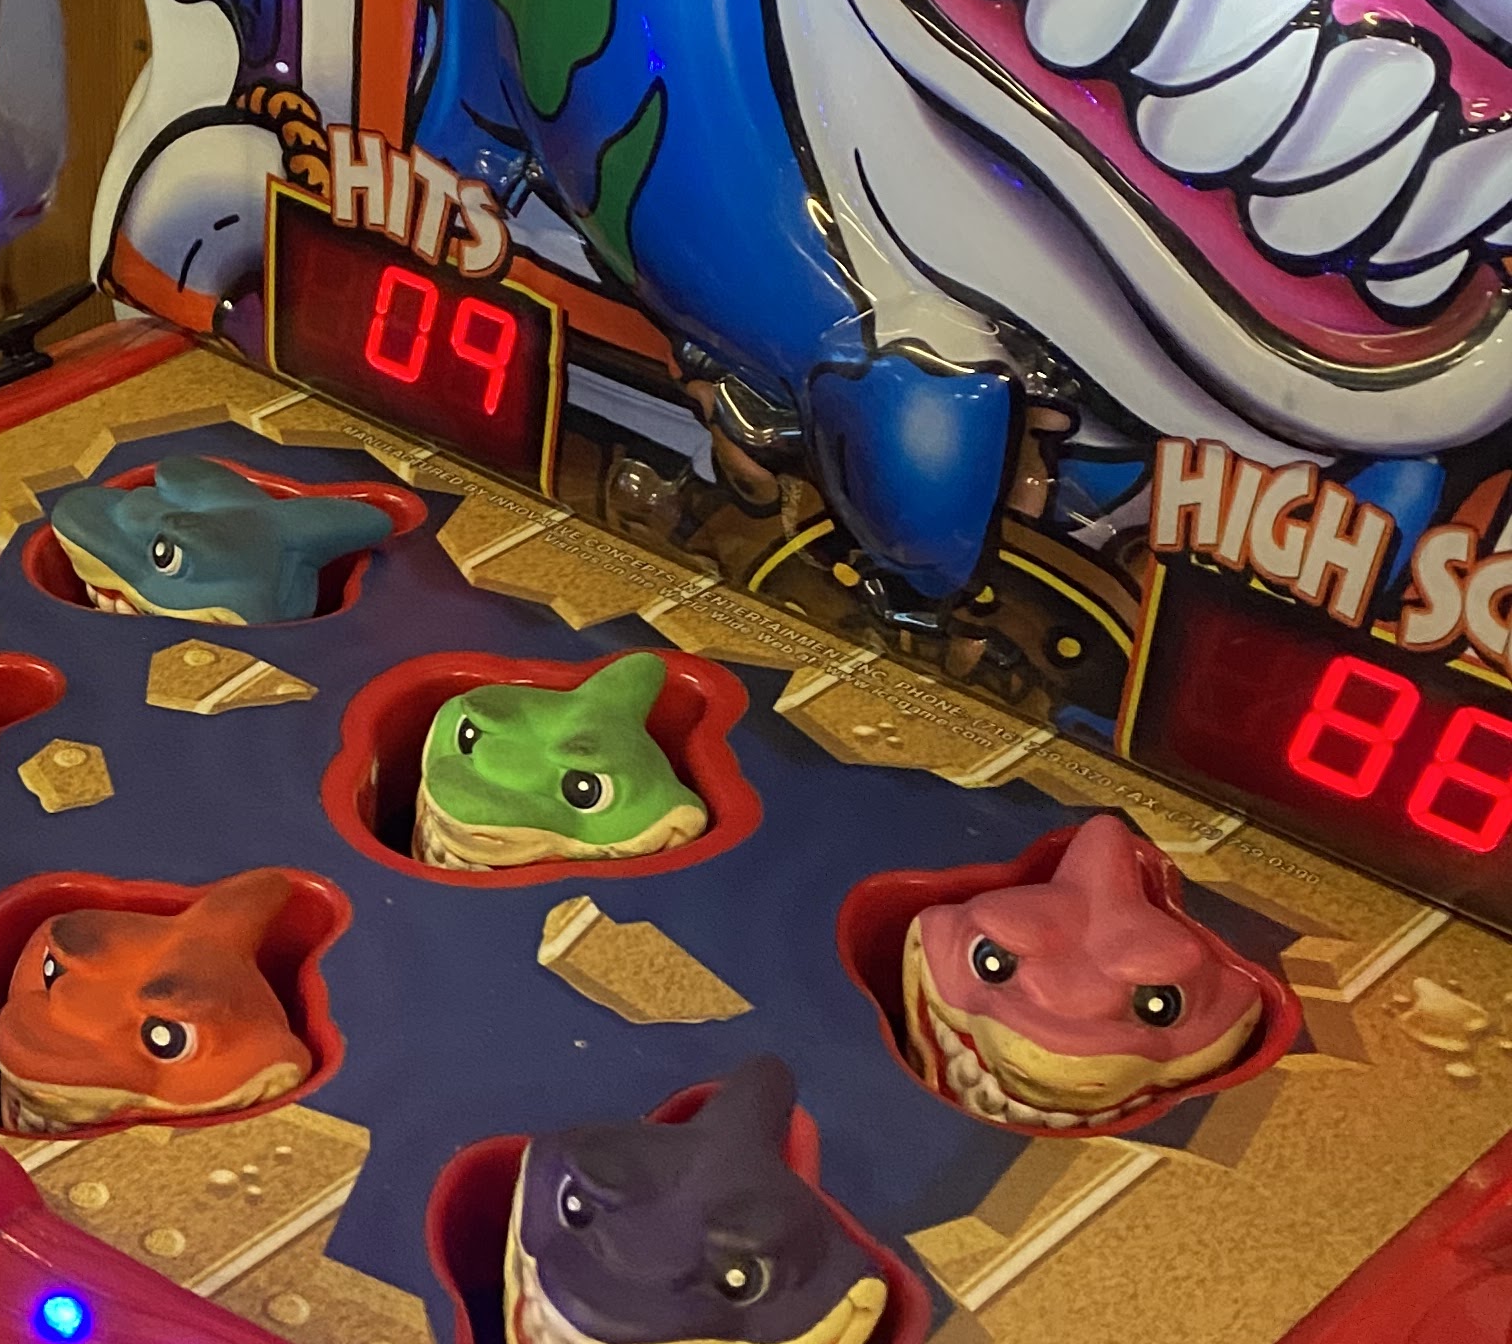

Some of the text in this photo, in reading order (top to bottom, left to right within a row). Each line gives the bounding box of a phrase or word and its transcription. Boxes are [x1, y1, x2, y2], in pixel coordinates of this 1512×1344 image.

[327, 124, 512, 278] HITS
[365, 264, 518, 416] 09
[464, 482, 489, 498] BY
[488, 494, 582, 541] INNOVATIVE
[585, 537, 679, 583] CONCEPTS
[698, 590, 849, 663] ENTERTAINMENT
[544, 532, 577, 555] Visit
[603, 562, 625, 577] on
[629, 573, 655, 590] the
[659, 586, 709, 613] World
[711, 610, 754, 634] Wide
[757, 632, 793, 654] Web
[1152, 437, 1512, 676] HIGH SC
